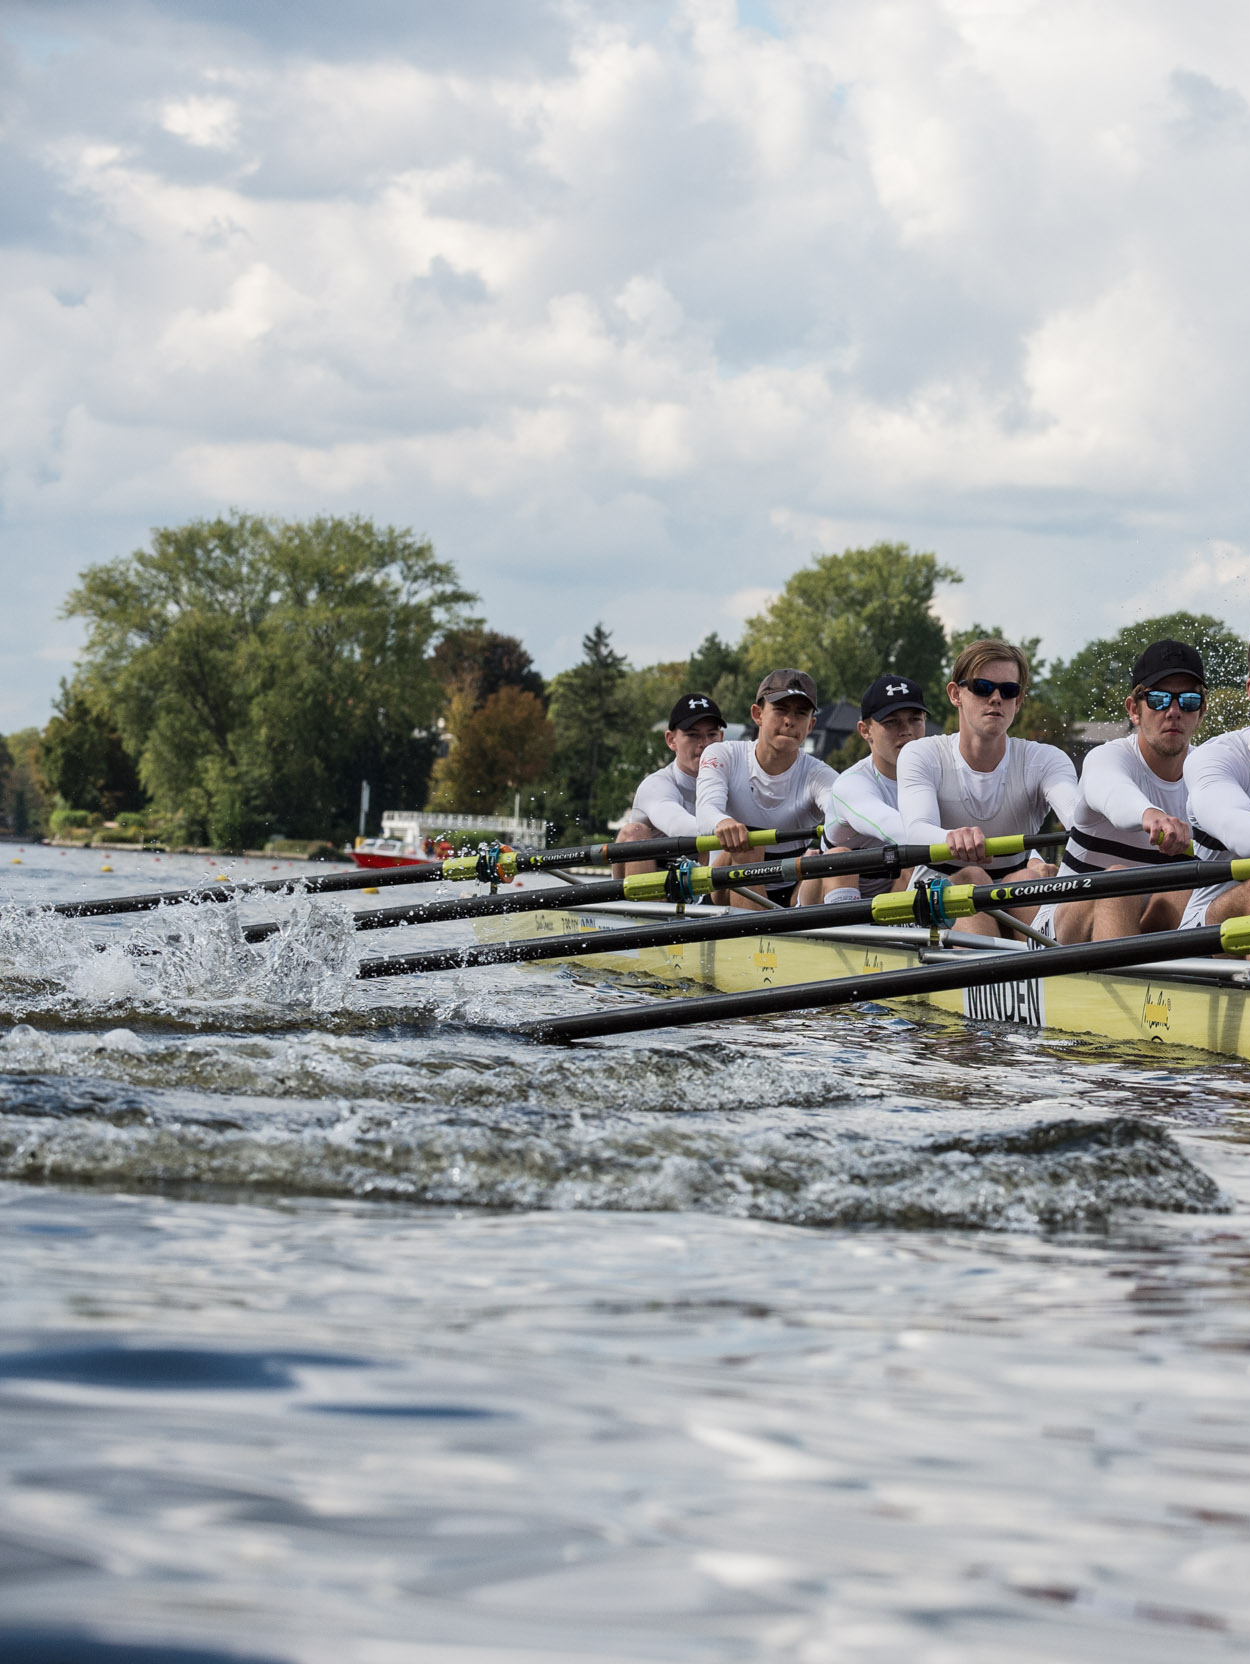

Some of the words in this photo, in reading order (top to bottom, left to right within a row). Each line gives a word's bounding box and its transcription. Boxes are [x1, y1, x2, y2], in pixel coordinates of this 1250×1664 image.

[744, 866, 783, 876] concep
[1014, 880, 1078, 896] concept
[1082, 878, 1092, 888] 2
[967, 978, 1042, 1027] MINDEN
